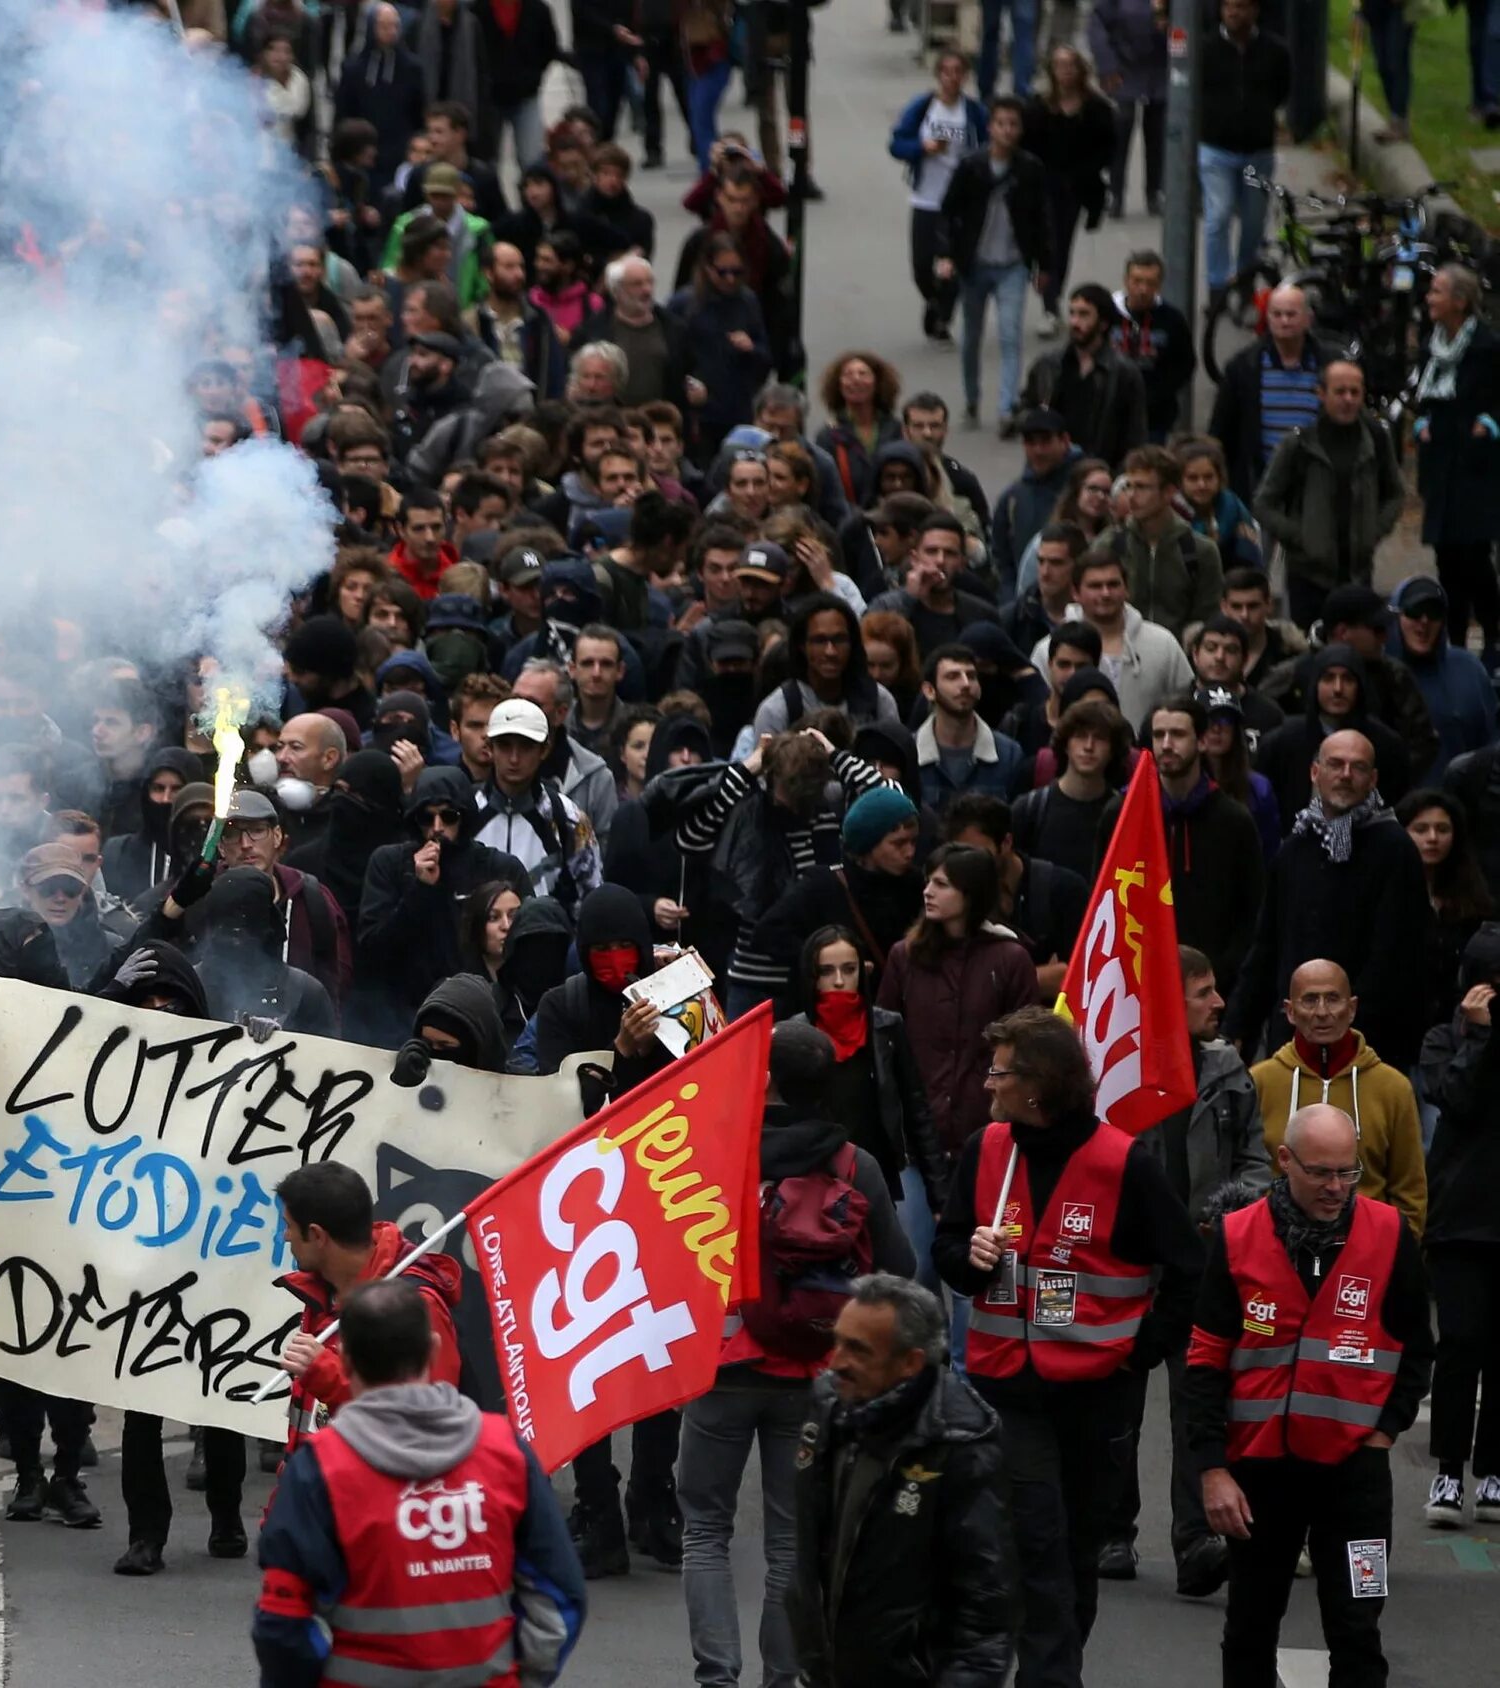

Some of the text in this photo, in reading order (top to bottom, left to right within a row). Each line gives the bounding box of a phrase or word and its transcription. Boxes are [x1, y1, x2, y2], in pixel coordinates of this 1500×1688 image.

[5, 1006, 374, 1166] LUTTER
[1064, 1215, 1090, 1232] cgt
[532, 1137, 697, 1413] cgt
[1341, 1289, 1366, 1307] cgt
[1247, 1301, 1276, 1321] cgt
[397, 1482, 488, 1550] cgt
[409, 1554, 492, 1577] UL NANTES
